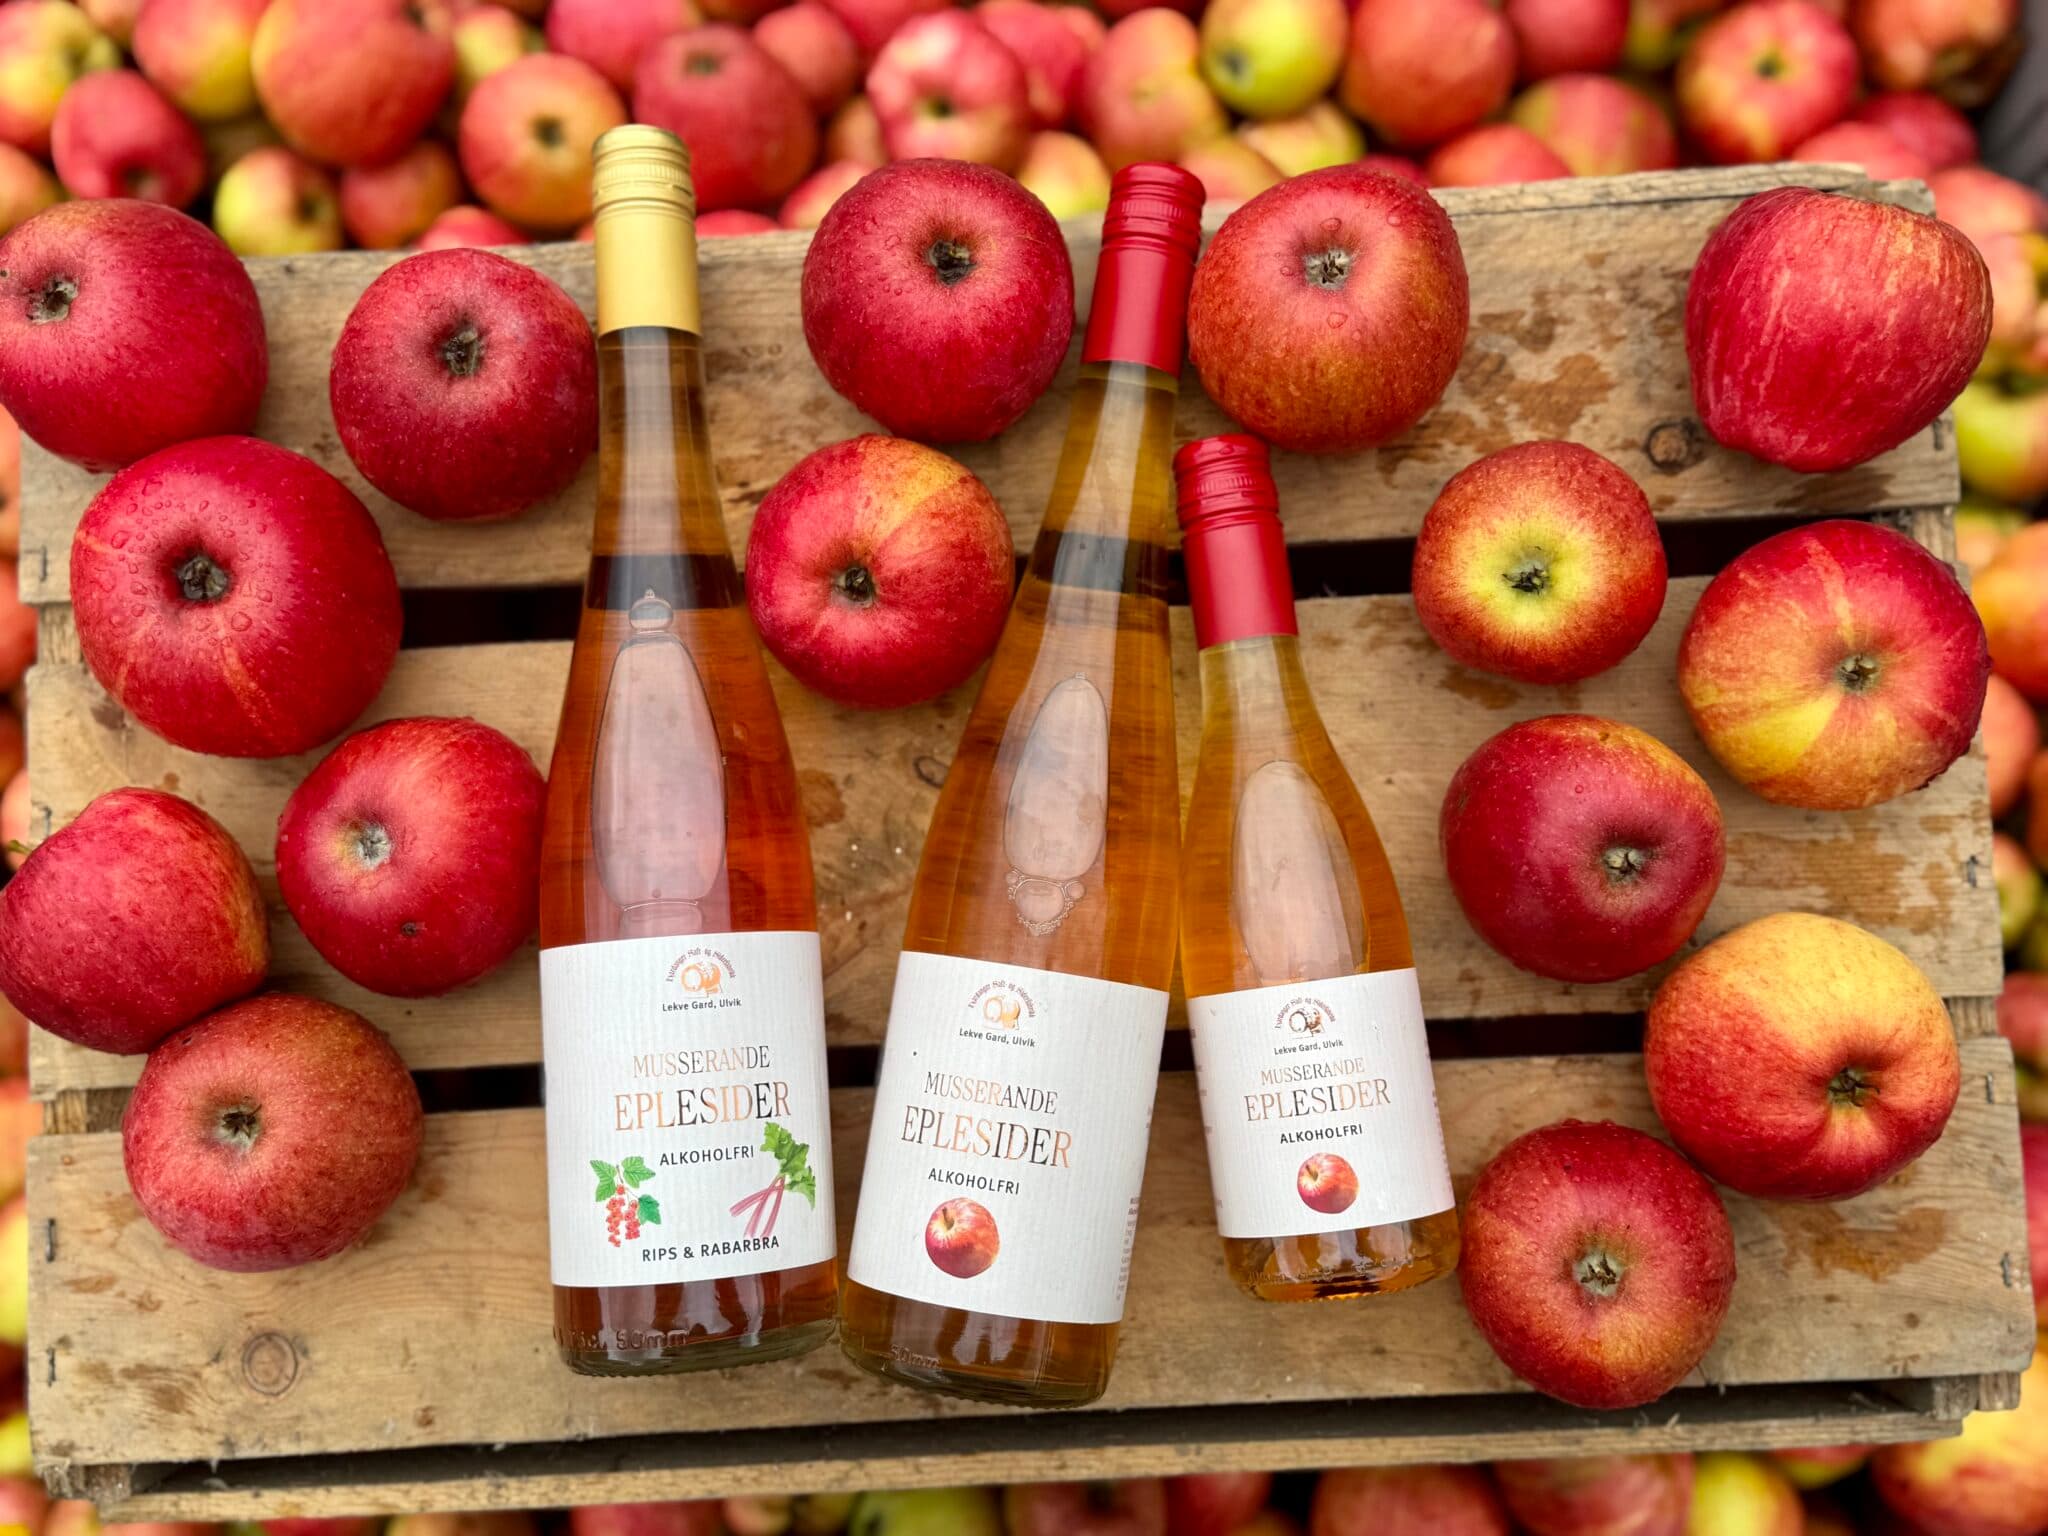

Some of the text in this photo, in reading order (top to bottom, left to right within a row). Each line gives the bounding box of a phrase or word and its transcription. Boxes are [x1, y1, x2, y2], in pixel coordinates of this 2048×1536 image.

[662, 998, 742, 1012] Lekve Gard, Ulvik
[959, 1028, 1036, 1048] Lekve Gard, Ulvik
[1273, 1039, 1344, 1055] Lekve Gard, Ulvik
[633, 1045, 771, 1078] MUSSERANDE
[1261, 1057, 1366, 1086] MUSSERANDE
[613, 1080, 792, 1131] EPLESIDER
[923, 1071, 1058, 1115] MUSSERANDE
[1243, 1078, 1392, 1121] EPLESIDER
[901, 1105, 1074, 1169] EPLESIDER
[1279, 1124, 1363, 1144] ALKOHOLFRI
[659, 1145, 755, 1166] ALKOHOLFRI
[927, 1167, 1021, 1195] ALKOHOLFRI
[642, 1235, 780, 1262] RIPS & RABARBRA
